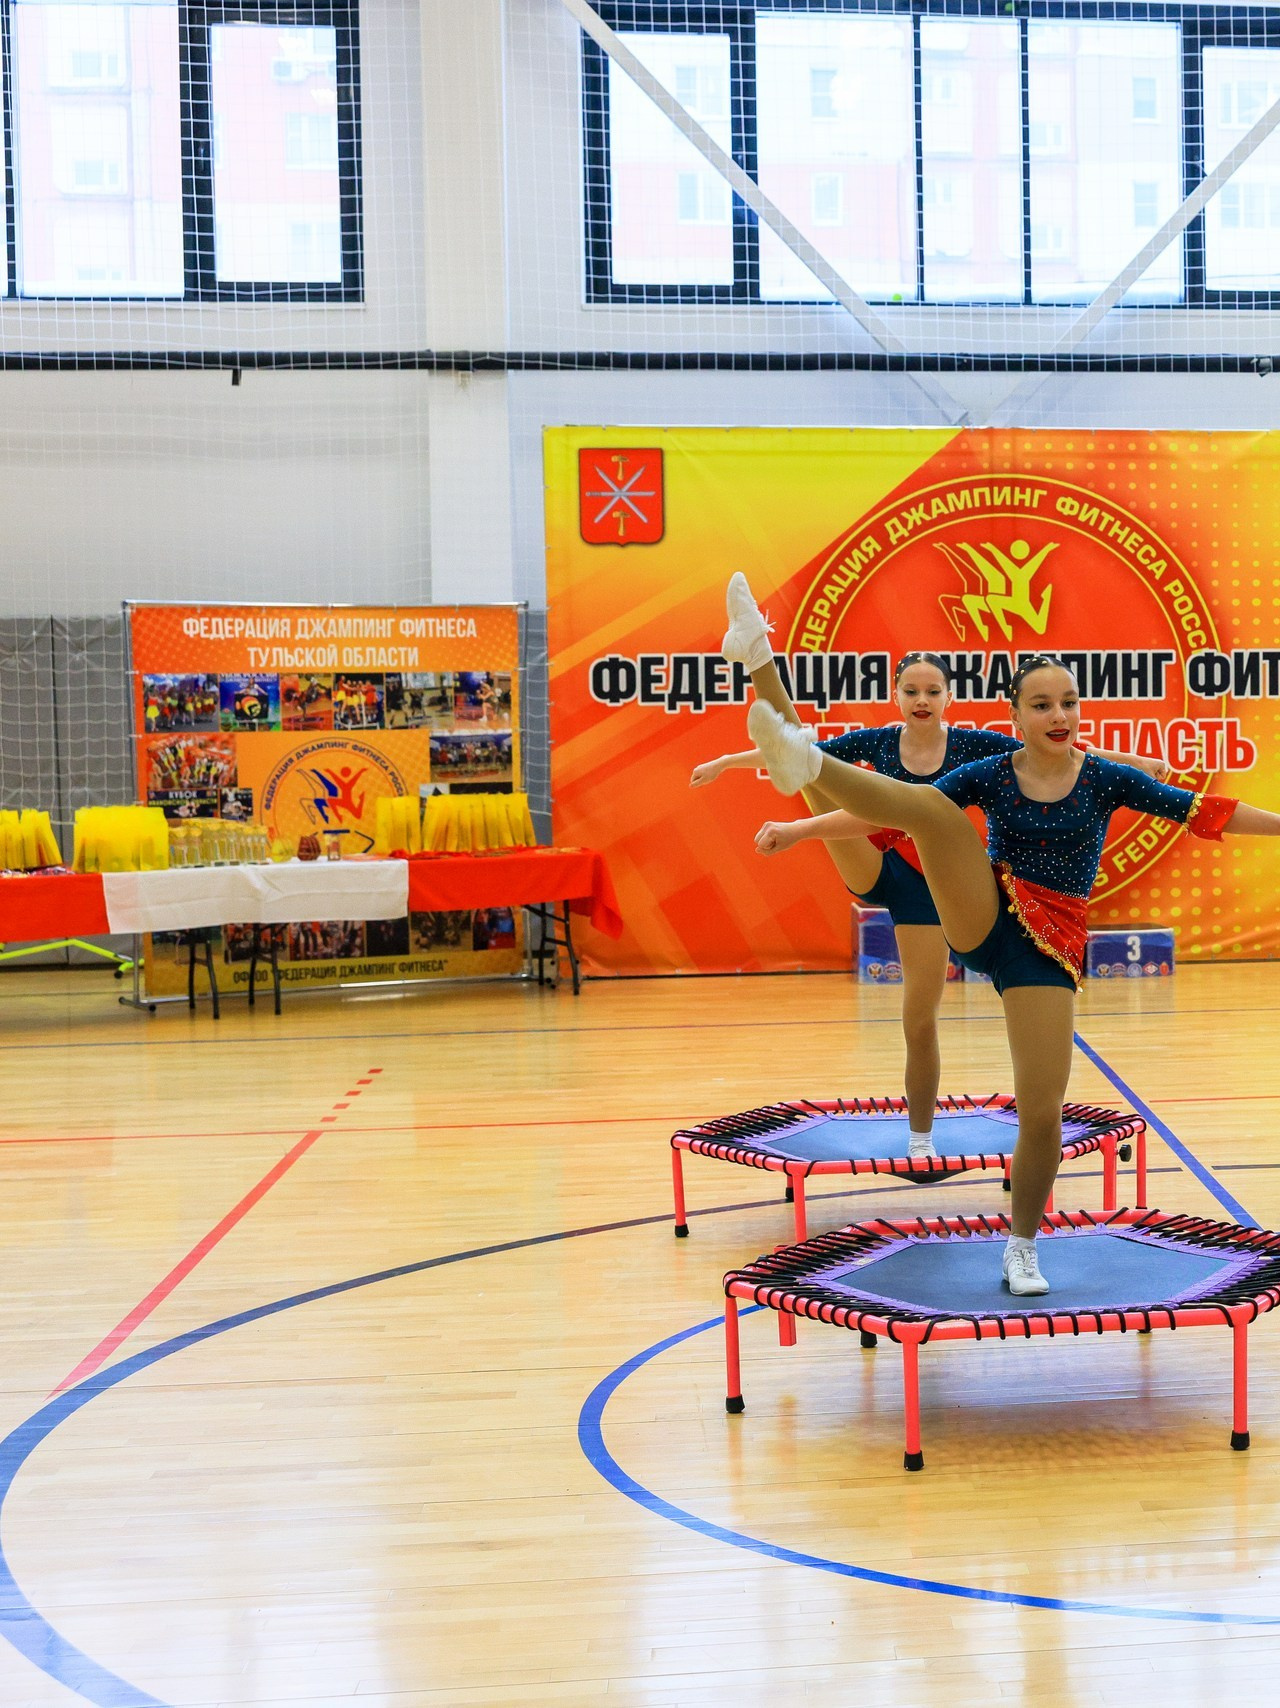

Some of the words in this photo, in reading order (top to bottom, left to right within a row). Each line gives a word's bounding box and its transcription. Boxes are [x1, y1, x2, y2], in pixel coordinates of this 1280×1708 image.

[800, 535, 882, 652] ДЕРАЦИЯ
[884, 486, 1047, 545] ДЖАМПИНГ
[1055, 496, 1168, 580] ФИТНЕСА
[1163, 579, 1209, 653] РОСС
[182, 618, 291, 640] ФЕДЕРАЦИЯ
[295, 617, 395, 640] ДЖАМПИНГ
[399, 617, 477, 638] ФИТНЕСА
[247, 645, 338, 668] ТУЛЬСКОЙ
[342, 646, 419, 667] ОБЛАСТИ
[906, 651, 1173, 699] ЖАПИНГ
[295, 741, 349, 760] ДЖАМПИНГ
[351, 743, 389, 771] ФИТНЕСА
[1077, 719, 1257, 772] ЛАСТЬ
[1127, 935, 1141, 962] 3
[339, 961, 395, 978] ДЖАМПИНГ
